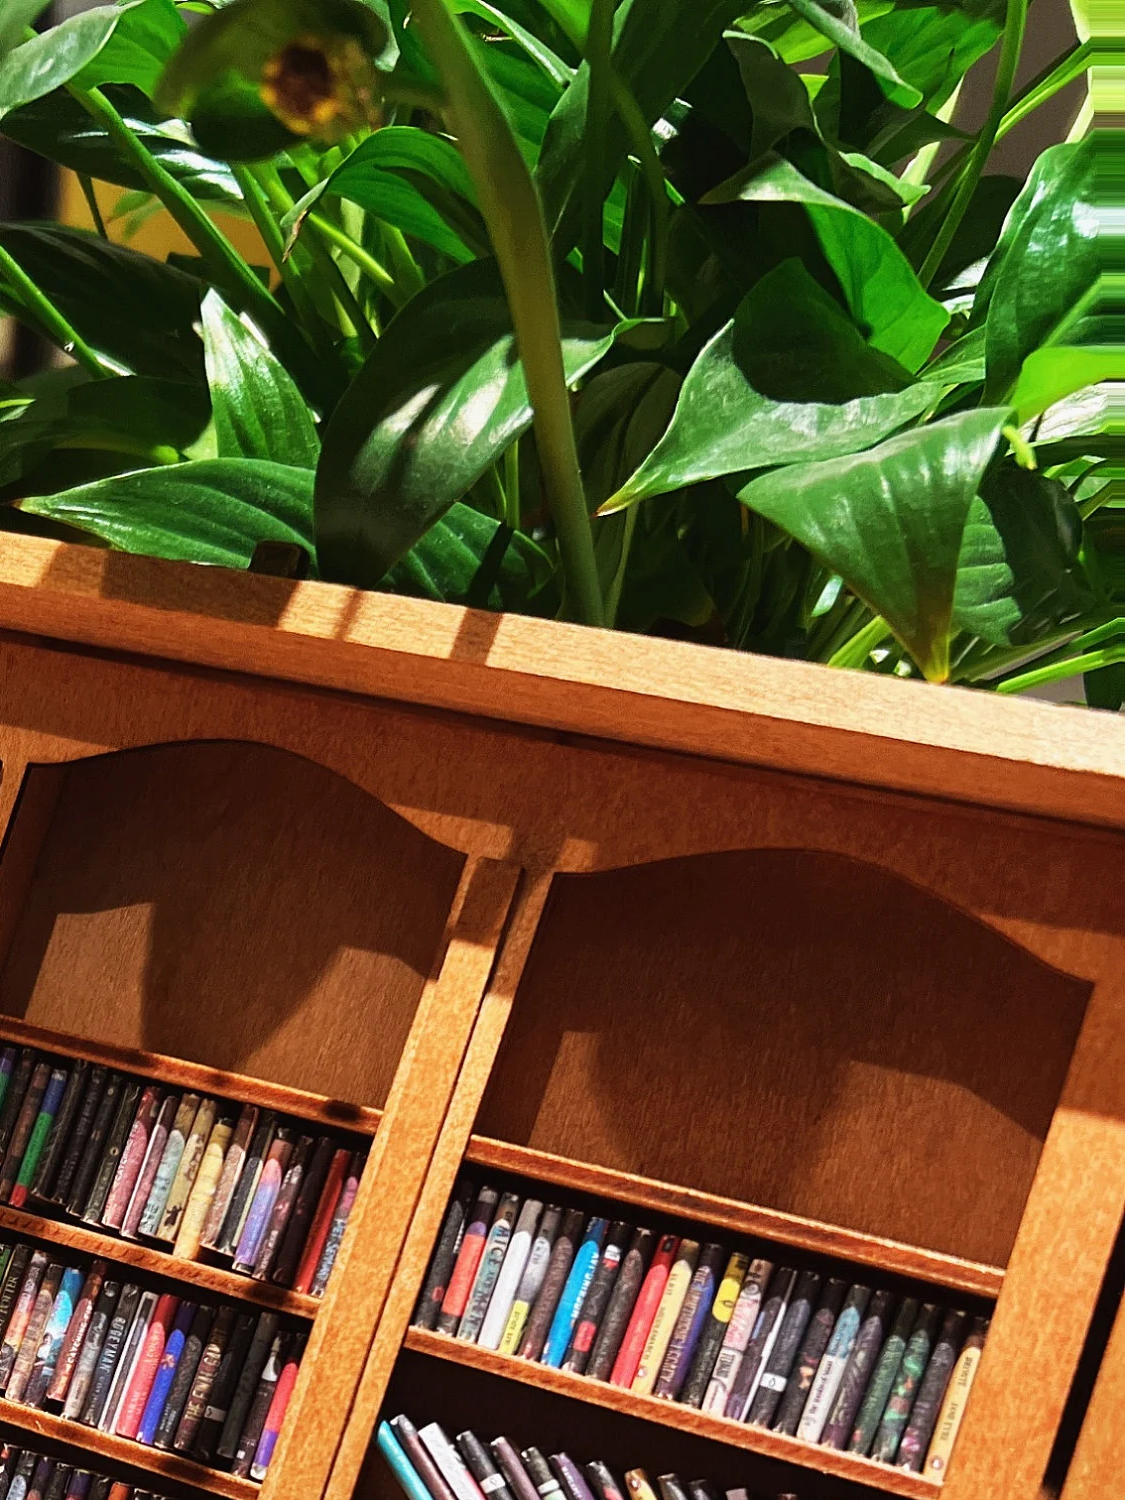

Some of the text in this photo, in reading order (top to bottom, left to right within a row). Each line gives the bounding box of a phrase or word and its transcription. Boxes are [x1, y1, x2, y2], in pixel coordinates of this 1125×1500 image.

[66, 1318, 88, 1365] CATCHING
[190, 1369, 214, 1401] FINAL
[184, 1400, 203, 1423] THE
